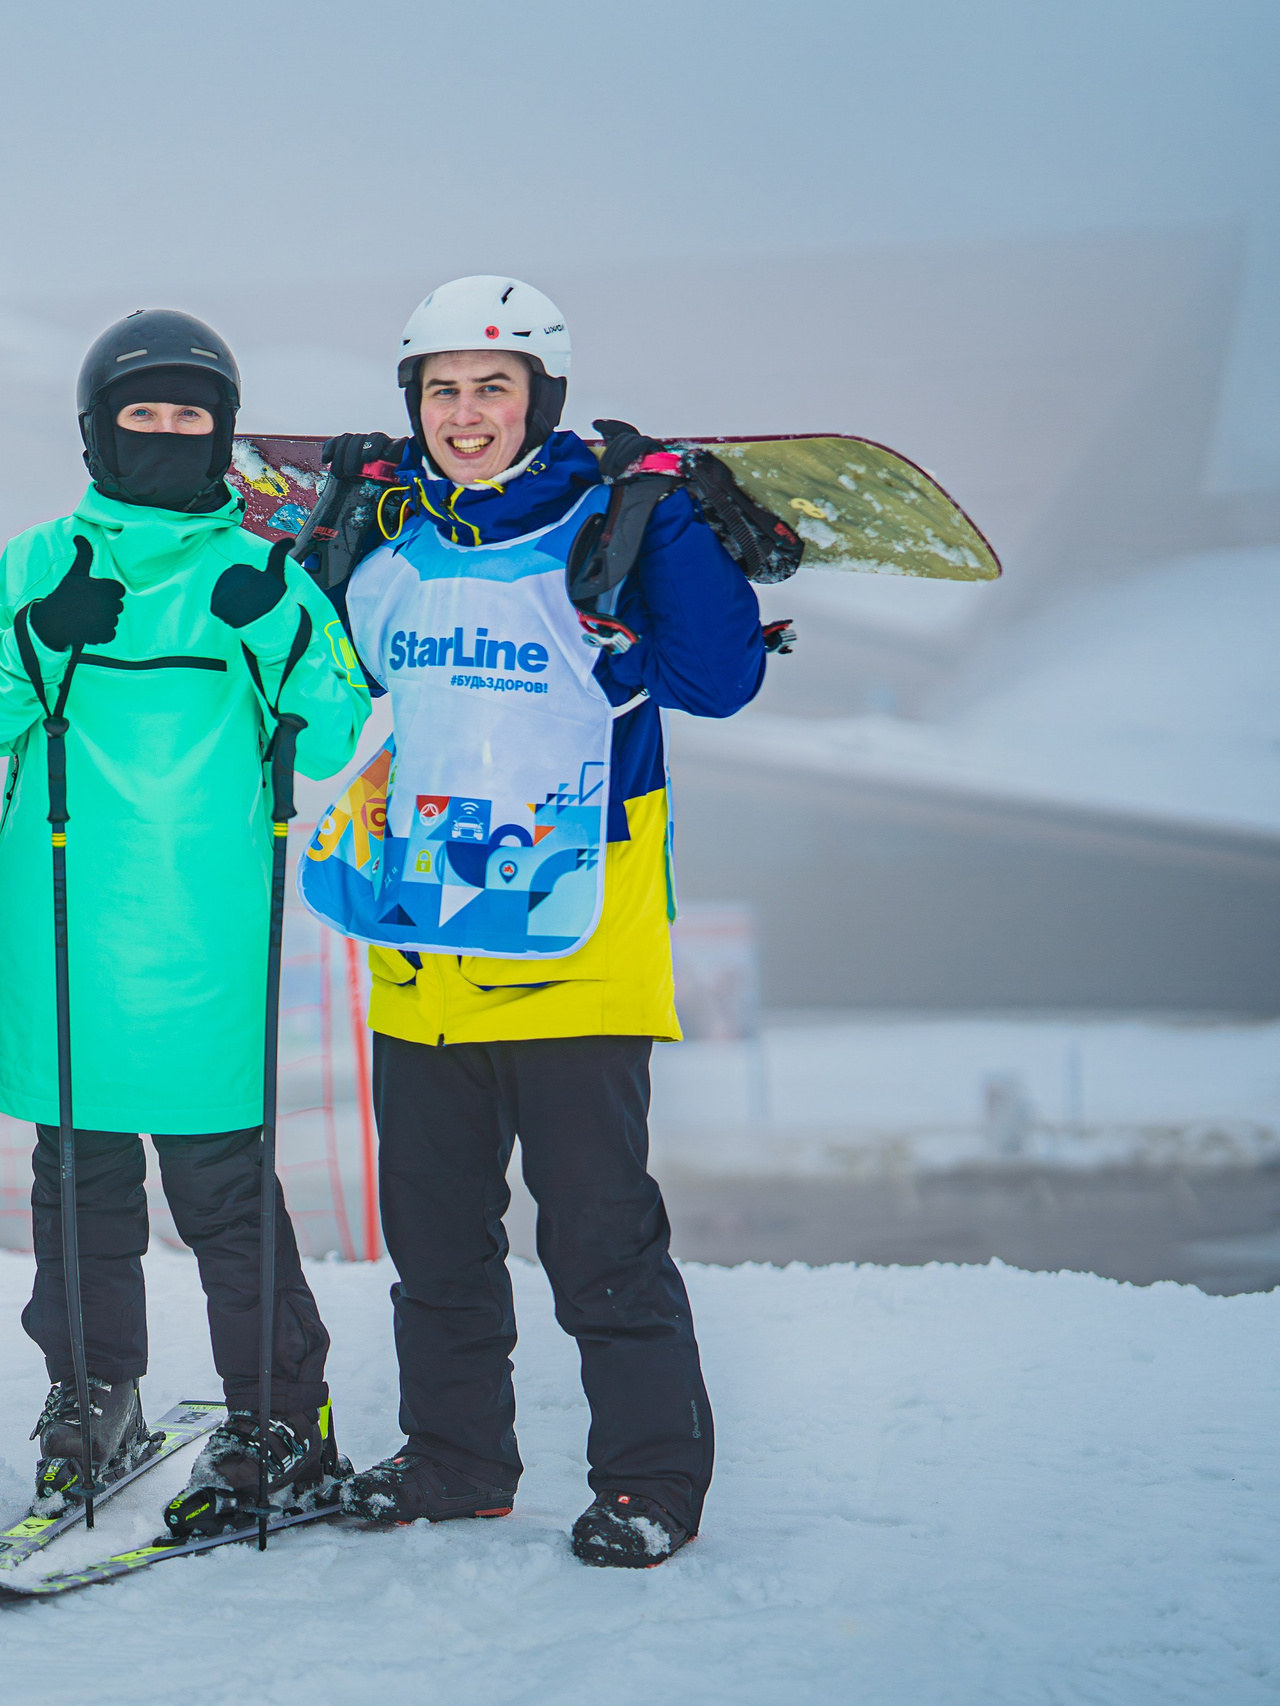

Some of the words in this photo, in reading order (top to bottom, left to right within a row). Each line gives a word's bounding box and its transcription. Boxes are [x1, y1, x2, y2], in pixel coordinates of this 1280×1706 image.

[389, 627, 549, 674] StarLine
[450, 675, 549, 694] #БУДЬЗДОРОВ!
[185, 1502, 210, 1521] FISCHER
